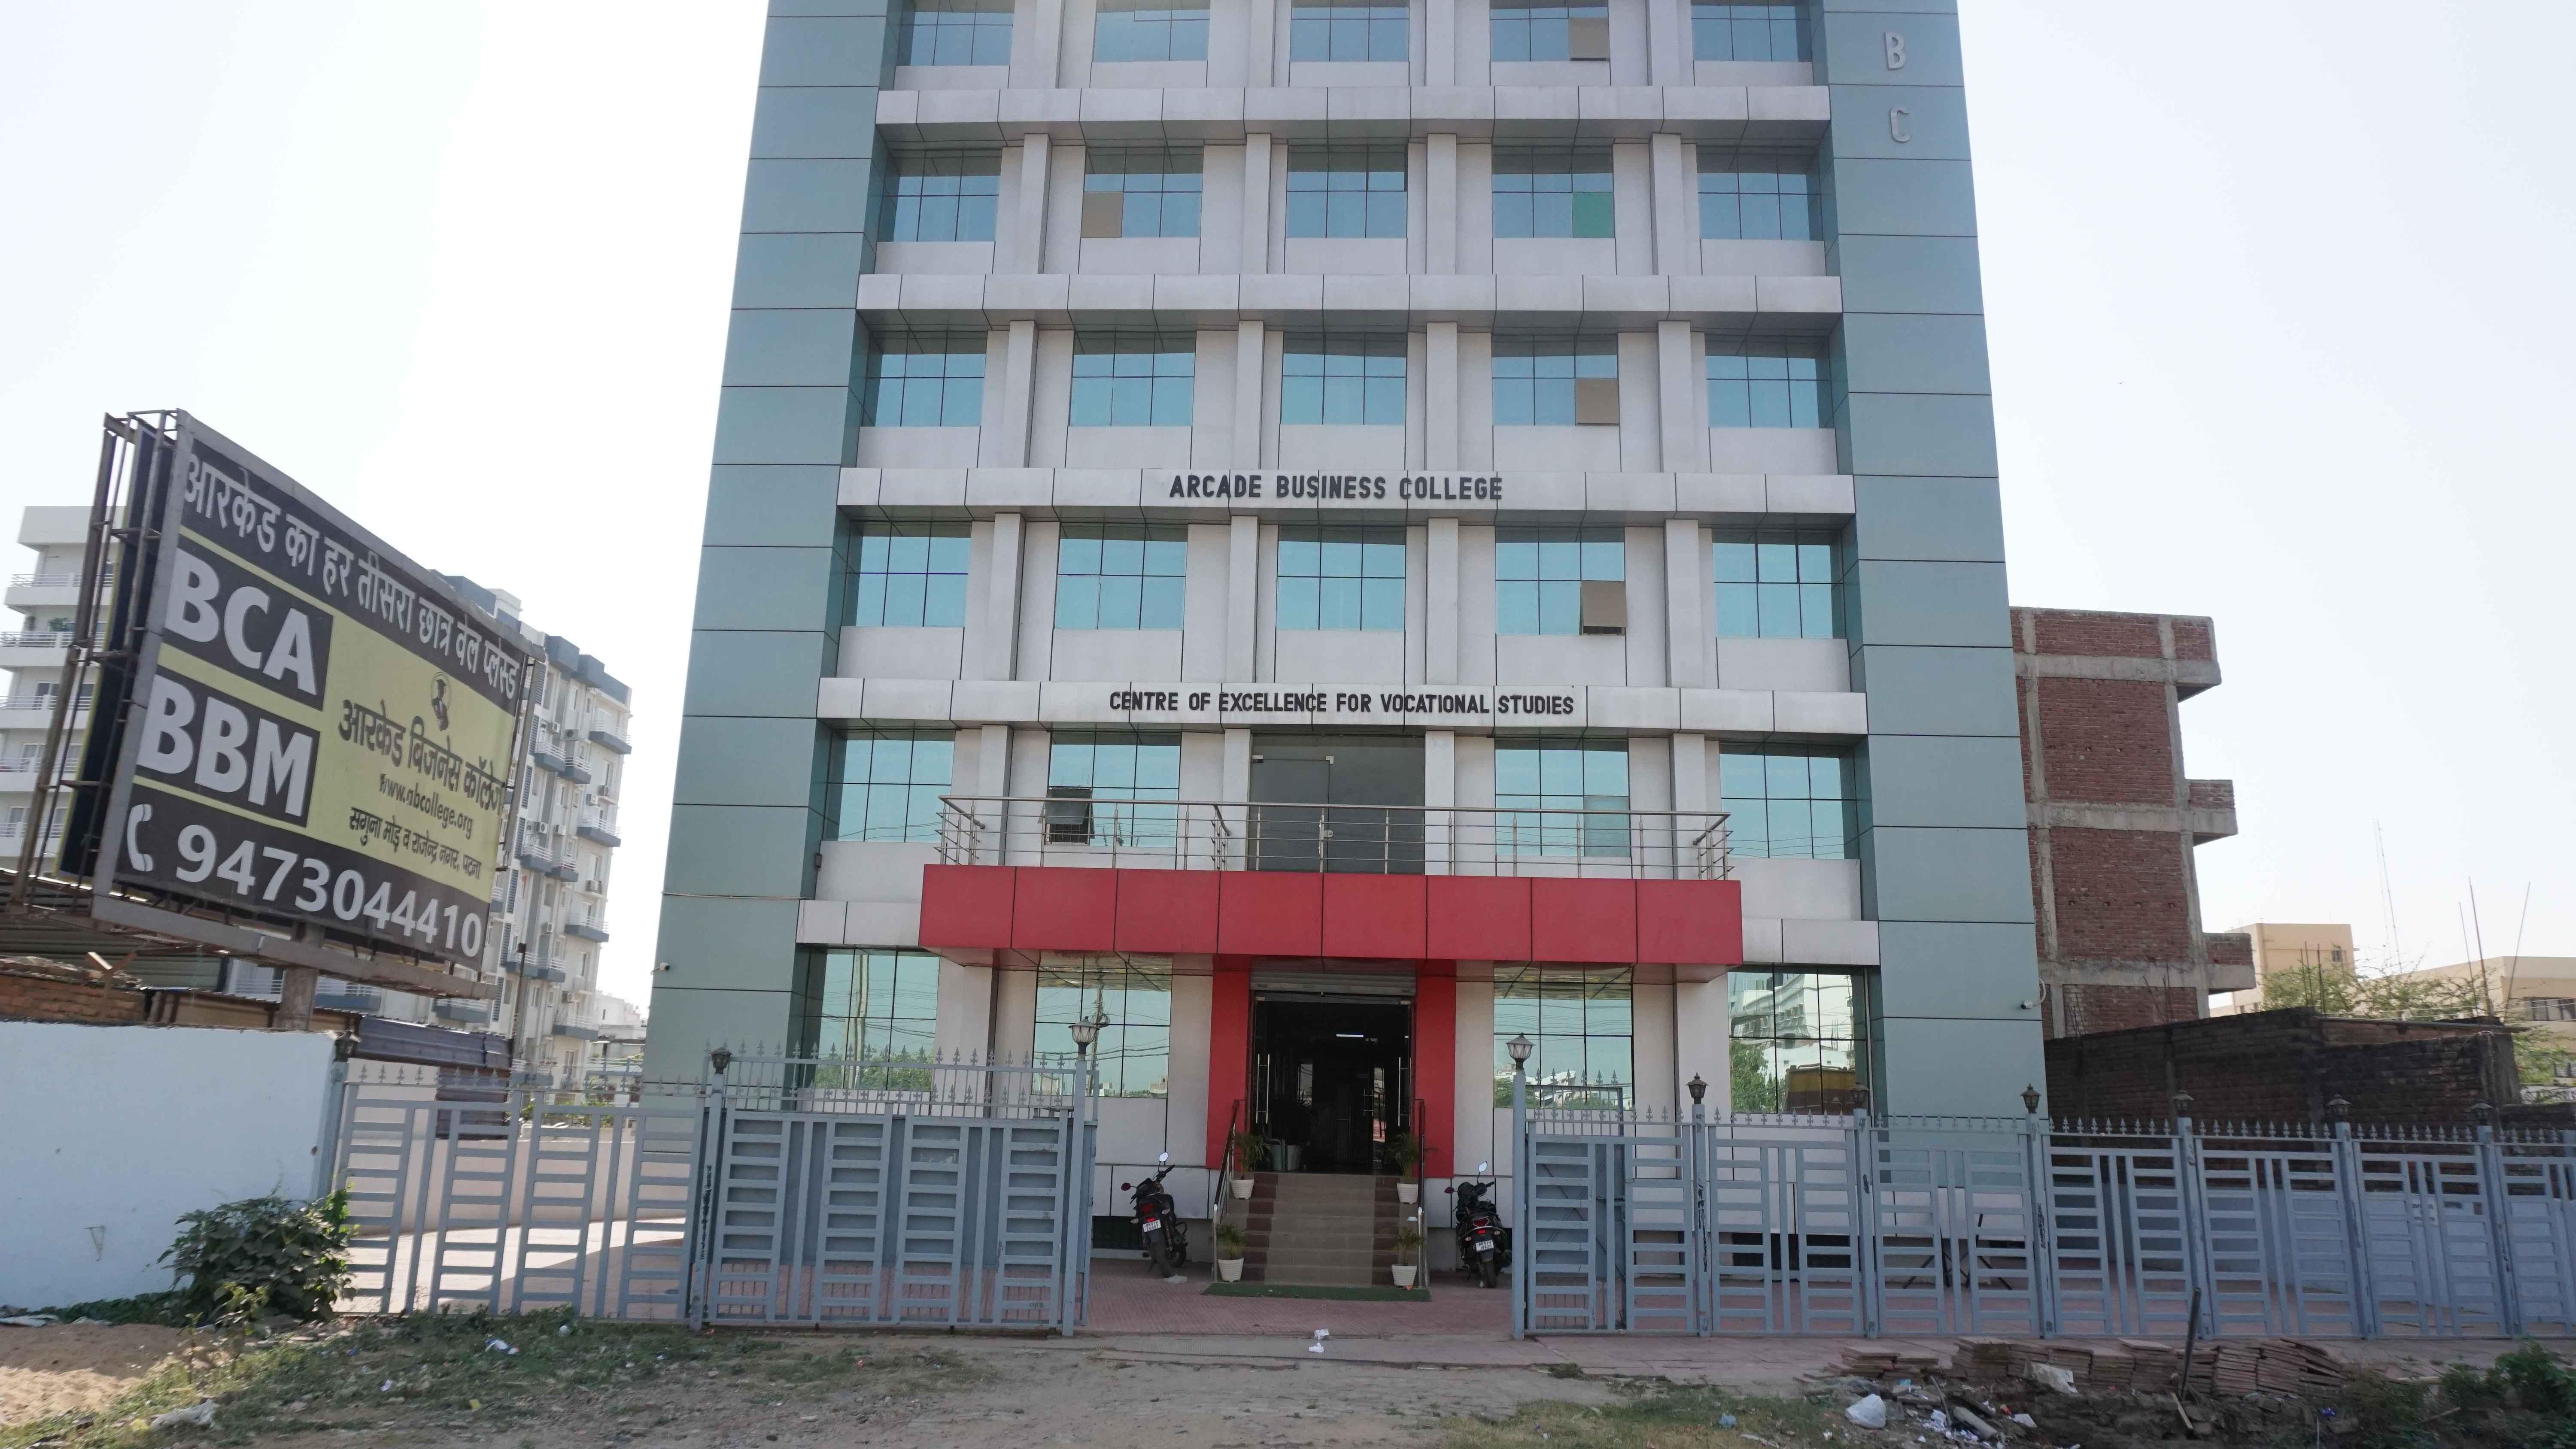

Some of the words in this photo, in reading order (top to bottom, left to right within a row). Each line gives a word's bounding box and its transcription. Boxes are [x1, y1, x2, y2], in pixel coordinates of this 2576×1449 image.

[1169, 474, 1261, 498] ARCADE
[1276, 475, 1386, 499] BUSINESS
[1400, 476, 1502, 500] COLLEGE
[164, 547, 317, 695] BCA
[184, 453, 282, 553] आरकेड
[285, 512, 320, 576] का
[323, 537, 354, 597] हर
[358, 549, 416, 633] तीसरा
[419, 597, 454, 656] छात्र
[456, 613, 482, 674] वेल
[483, 637, 520, 699] प्लेस्ड
[136, 673, 314, 817] BBM
[338, 698, 406, 767] आरकेड
[407, 715, 463, 792] बिजनेस
[1109, 691, 1179, 711] CENTRE
[1188, 692, 1211, 711] OF
[1218, 691, 1327, 713] EXCELLENCE
[1336, 693, 1372, 712] FOR
[1380, 693, 1490, 714] VOCATIONAL
[1498, 694, 1574, 715] STUDIES
[176, 824, 482, 958] 9473044410
[348, 806, 383, 846] सगुना
[402, 828, 411, 850] व
[462, 854, 482, 880] पटना
